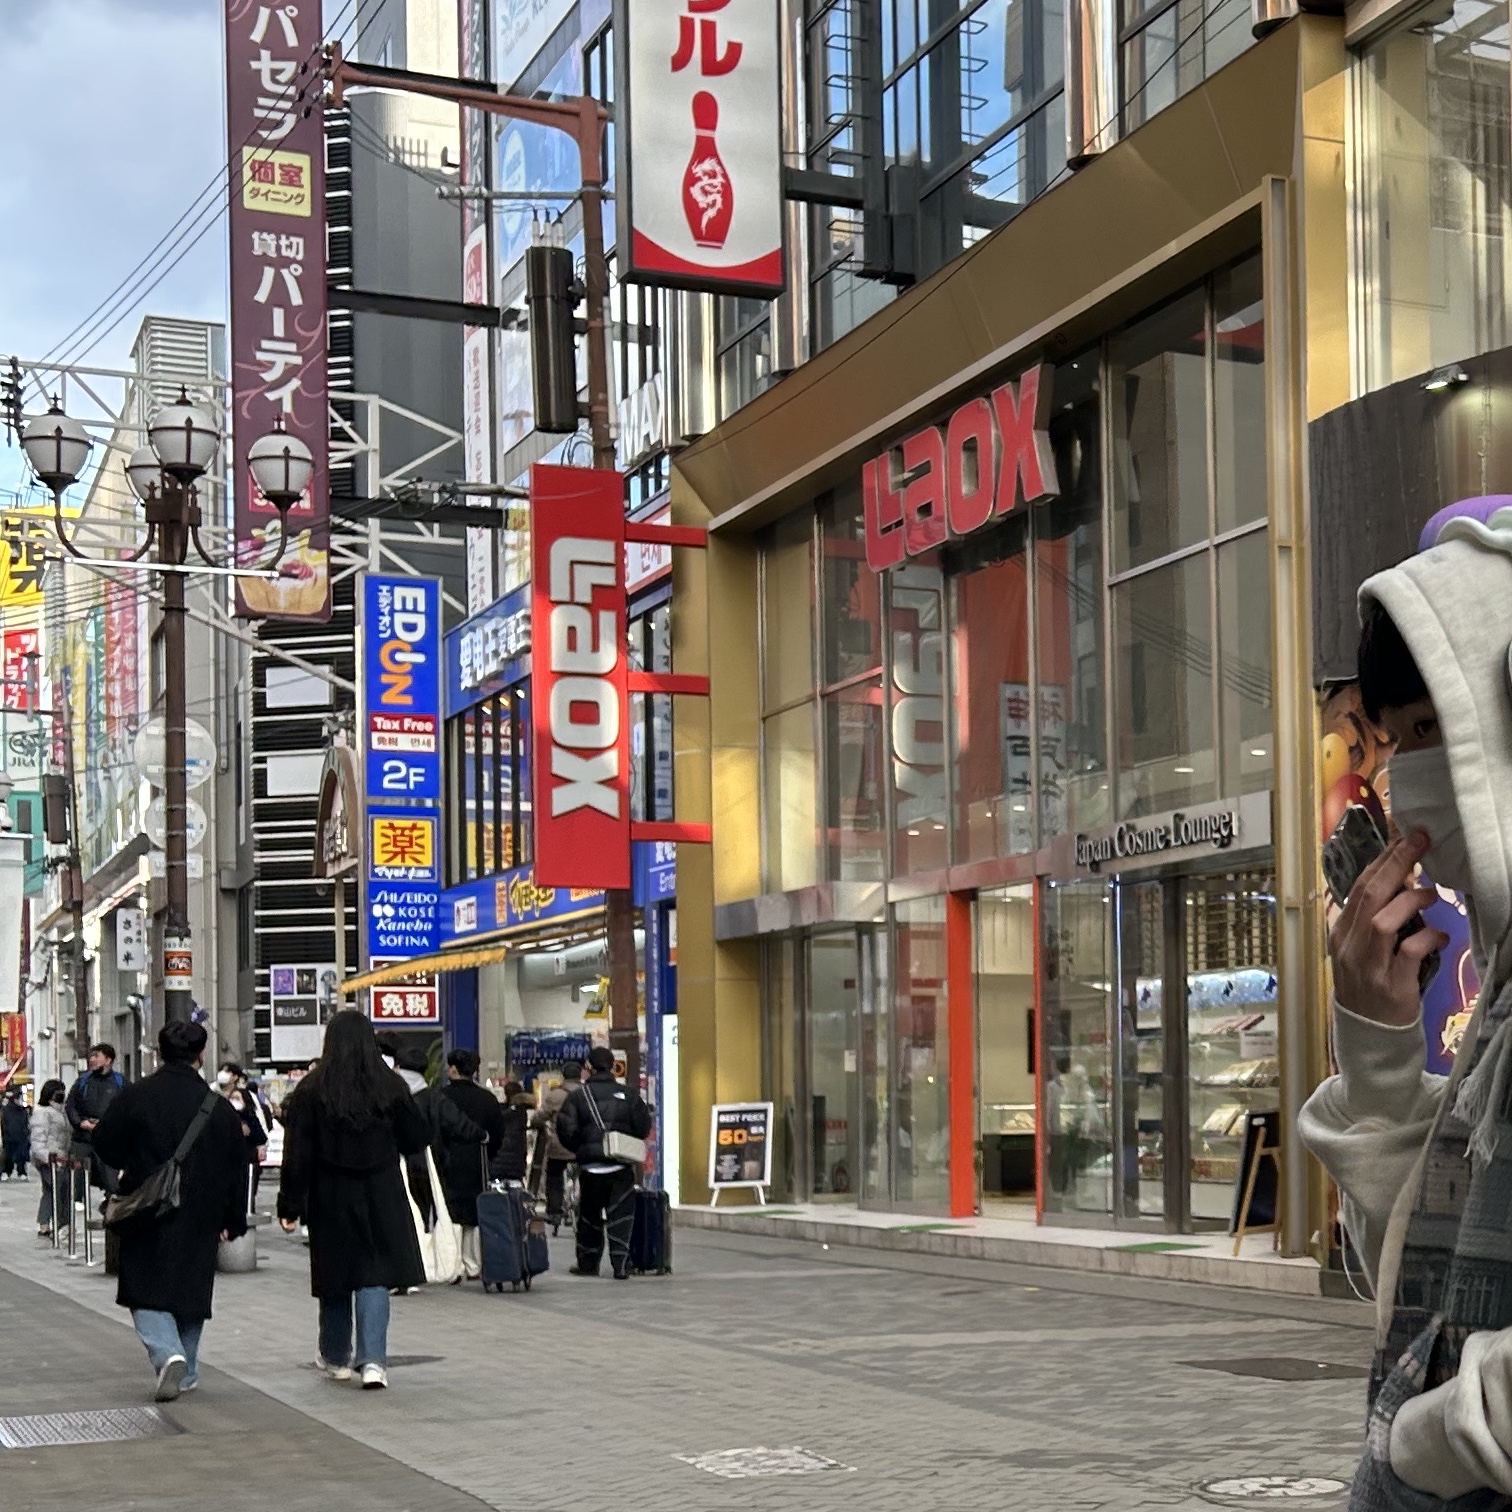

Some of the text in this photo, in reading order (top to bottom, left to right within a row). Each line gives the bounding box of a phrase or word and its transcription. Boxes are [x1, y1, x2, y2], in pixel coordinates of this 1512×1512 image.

[250, 5, 299, 141] パセラ
[250, 159, 304, 189] 個室
[249, 187, 305, 206] ダイニング
[252, 231, 305, 261] 貸切
[379, 585, 426, 706] EDION
[373, 716, 433, 732] Tax Free
[382, 760, 426, 790] 2F
[380, 821, 426, 864] 薬
[1114, 822, 1166, 858] Cosme
[370, 890, 438, 905] SHISEIDO
[375, 918, 434, 932] Kanebo
[378, 935, 430, 948] SOFINA
